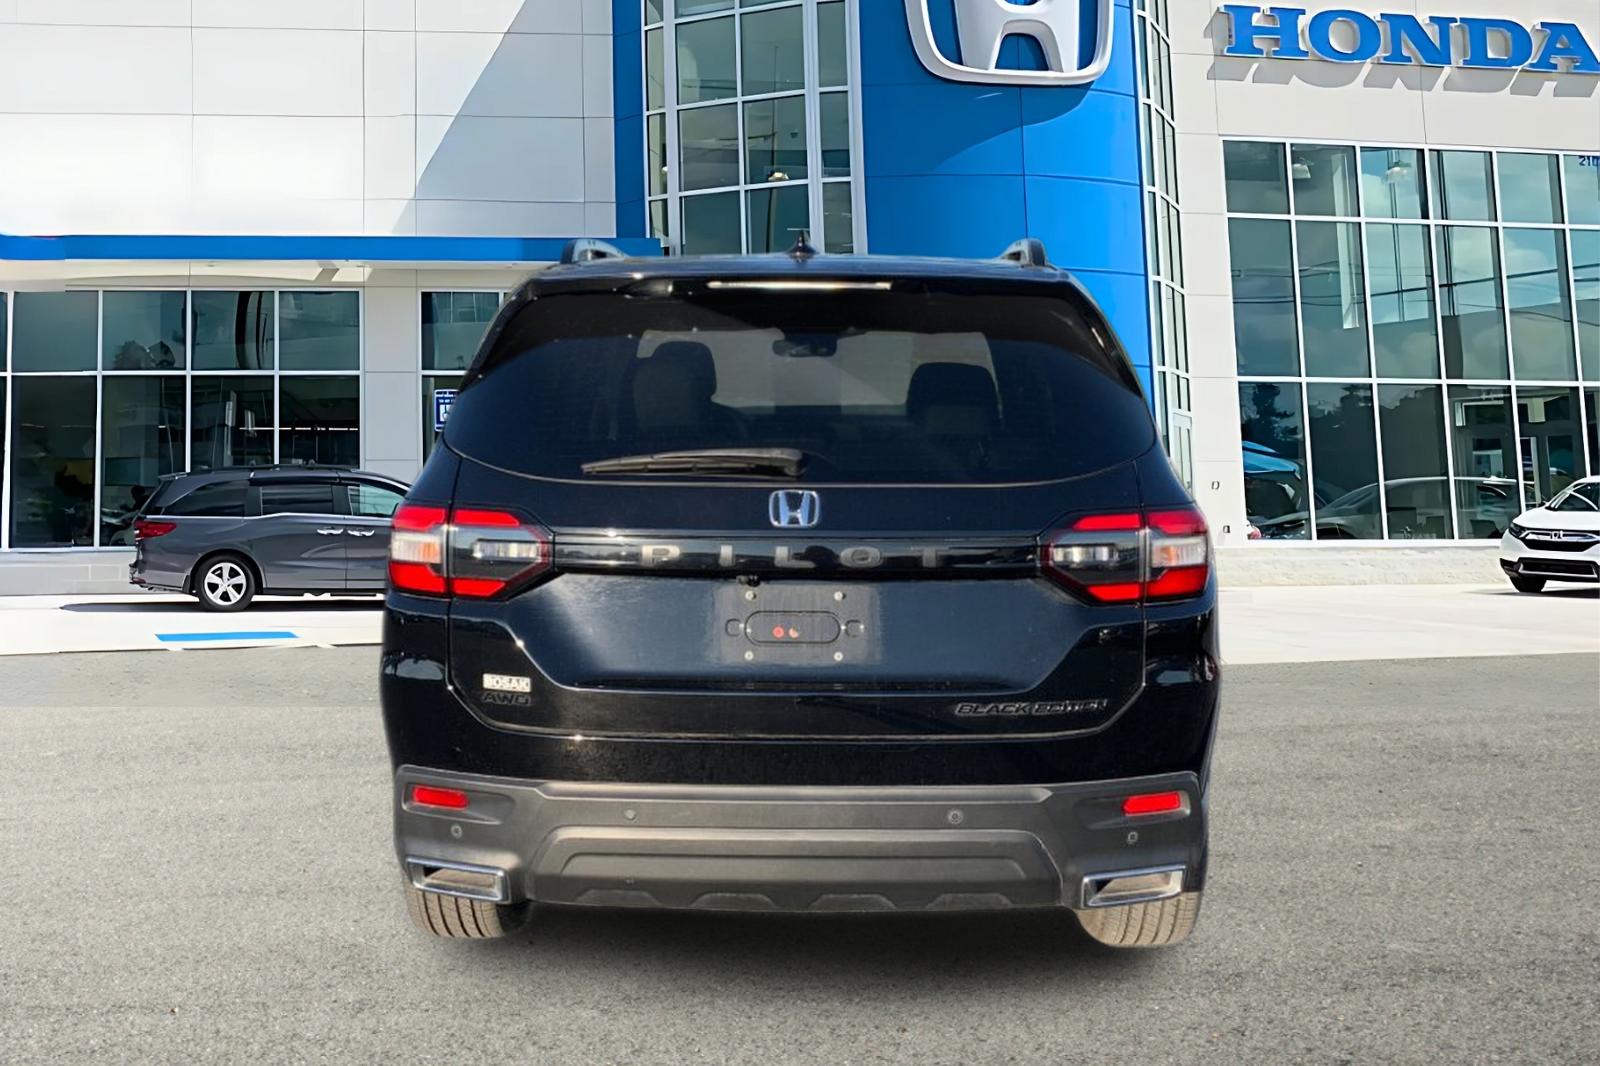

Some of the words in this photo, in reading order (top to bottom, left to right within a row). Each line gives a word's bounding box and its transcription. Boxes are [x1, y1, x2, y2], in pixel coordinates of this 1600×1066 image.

[1218, 4, 1600, 73] HONDA
[640, 544, 950, 569] PILOT
[482, 692, 532, 705] AWD
[954, 702, 1030, 717] BLACK
